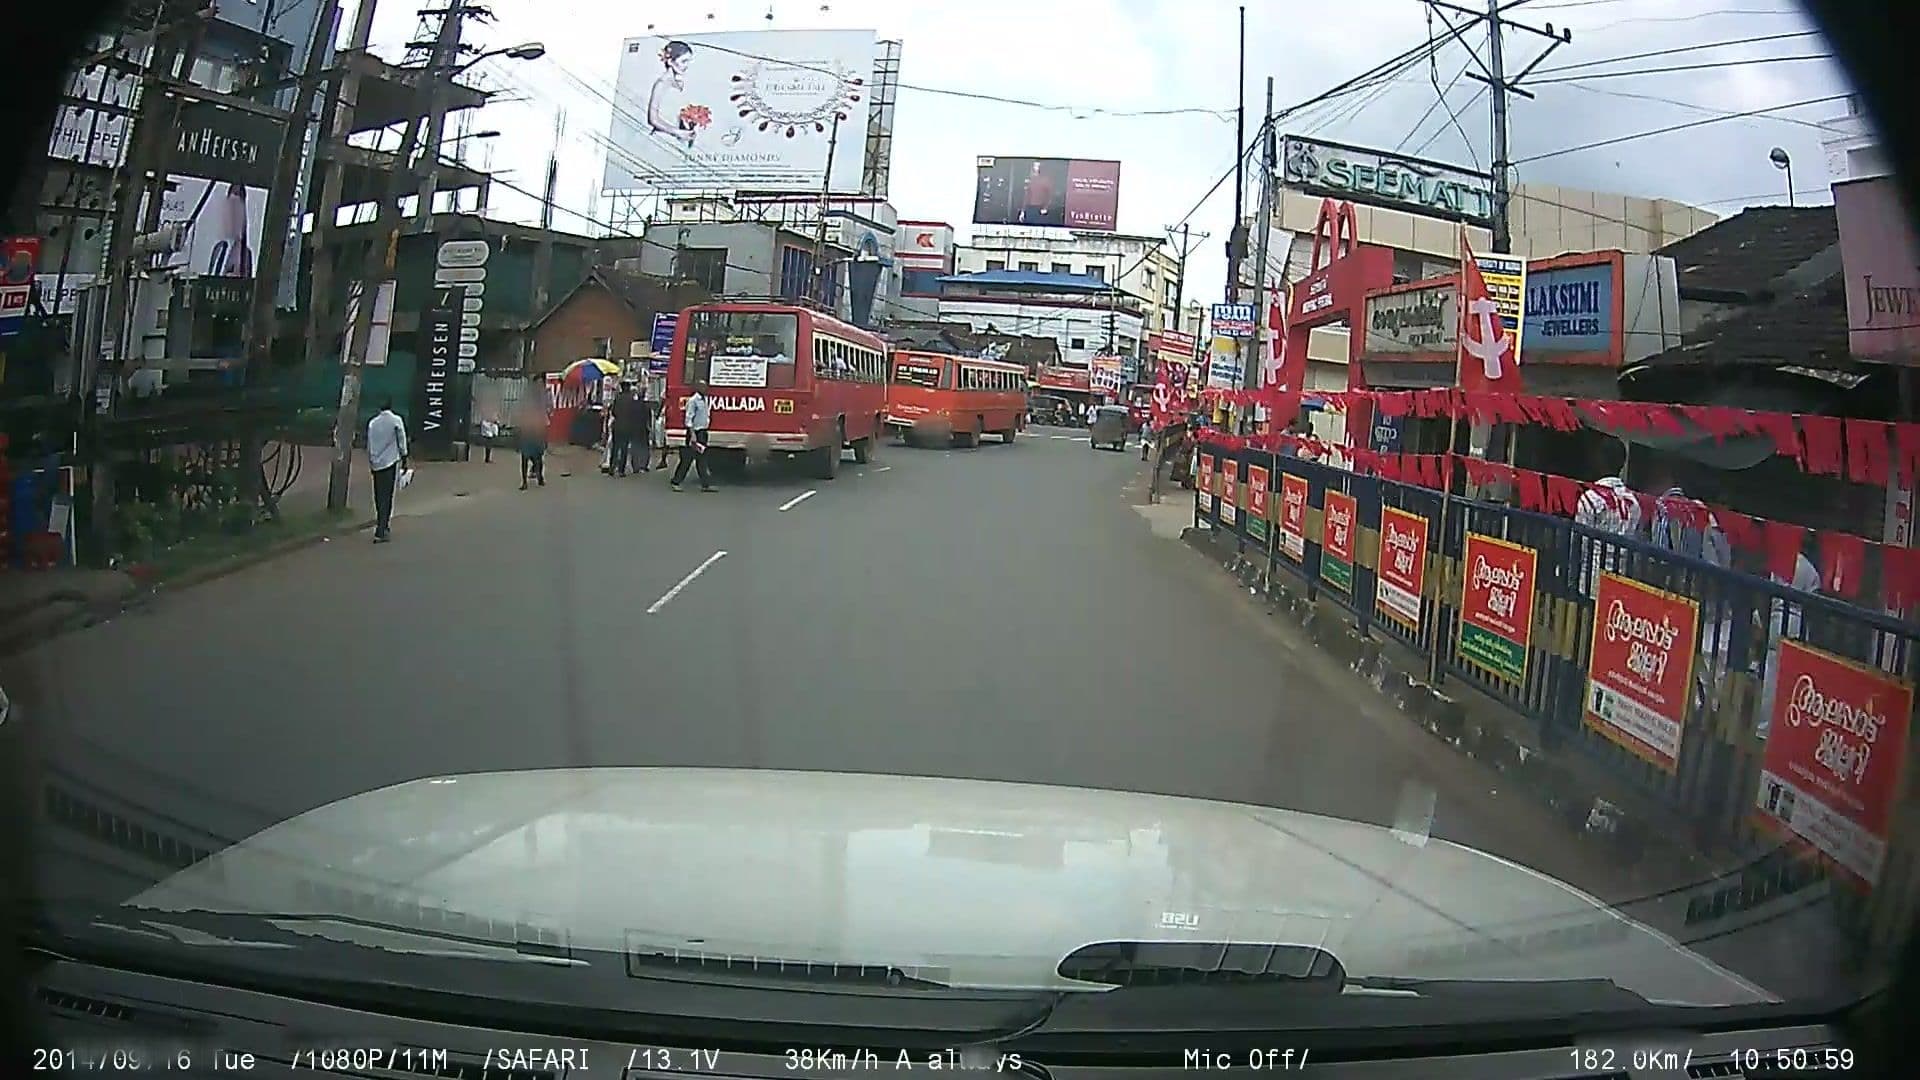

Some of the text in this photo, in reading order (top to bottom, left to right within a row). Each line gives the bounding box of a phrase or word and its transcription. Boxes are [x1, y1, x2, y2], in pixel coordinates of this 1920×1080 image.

[54, 127, 120, 148] PHILPPE
[1541, 318, 1600, 337] JEWELLERS
[708, 395, 766, 412] KALLADA
